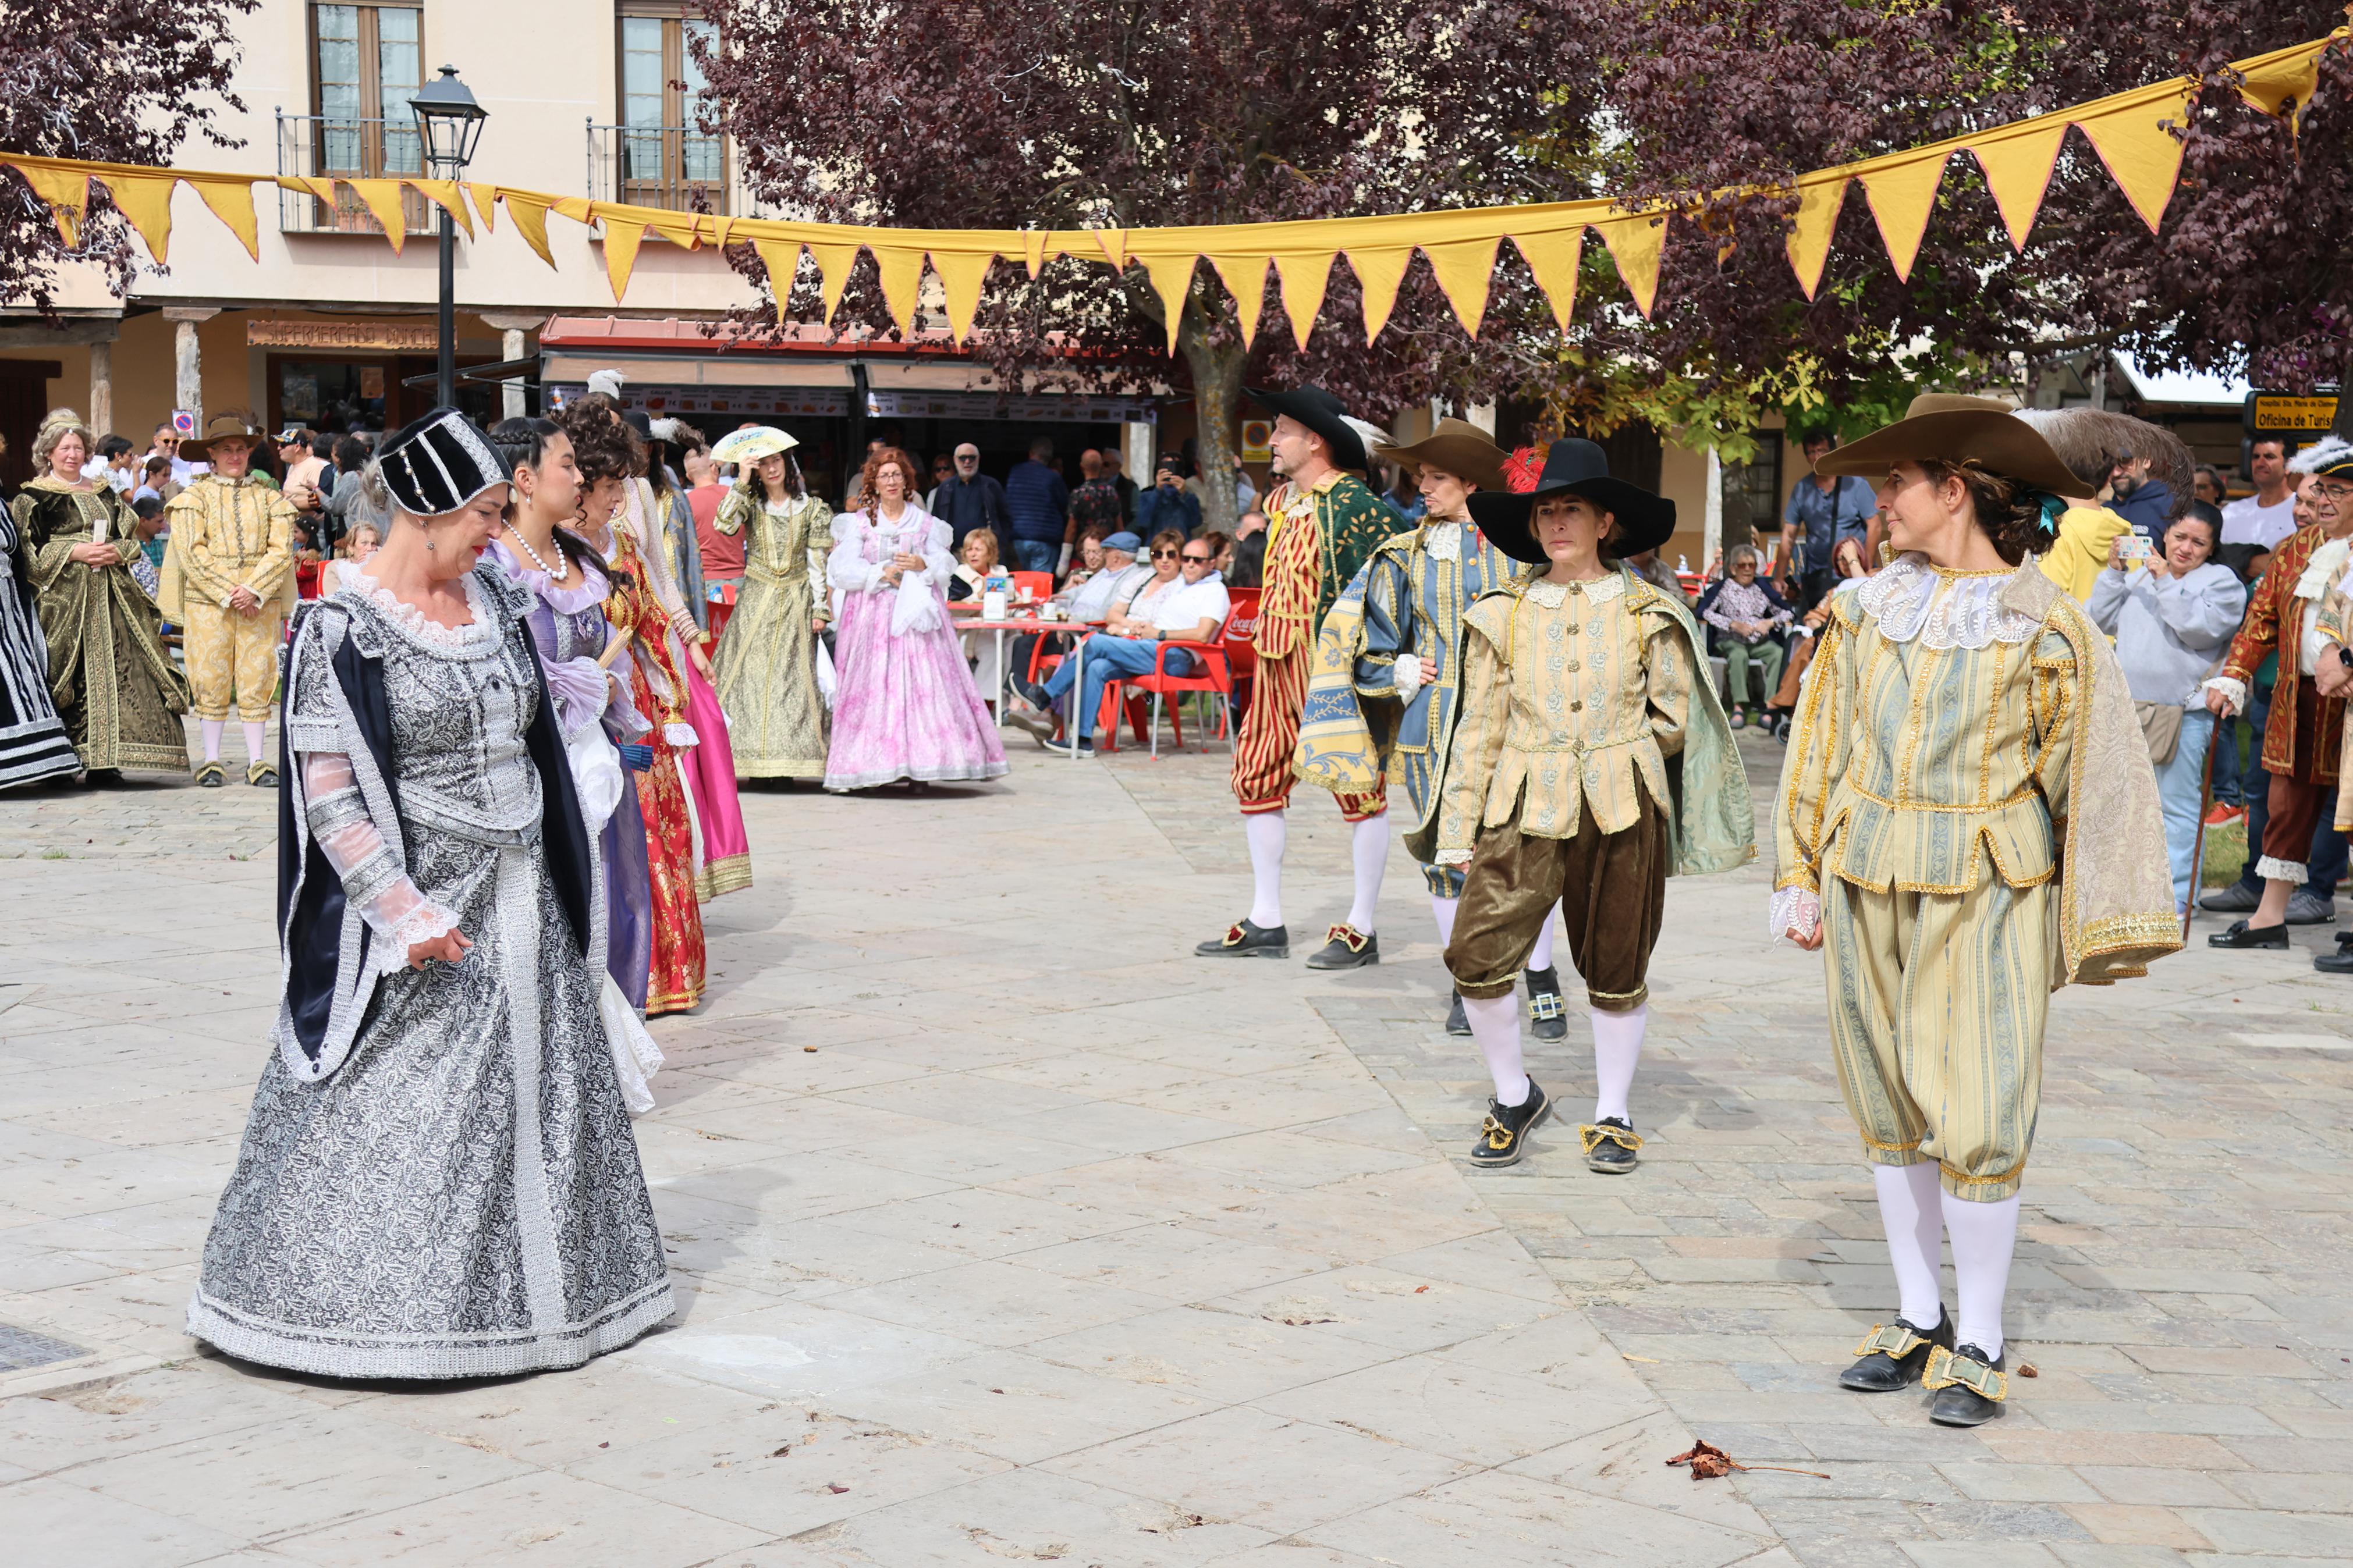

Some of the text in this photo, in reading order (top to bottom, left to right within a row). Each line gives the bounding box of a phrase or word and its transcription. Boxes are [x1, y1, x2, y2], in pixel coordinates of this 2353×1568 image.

[265, 325, 375, 344] SUPERMERCADO
[2259, 413, 2333, 427] Oficina de Turis
